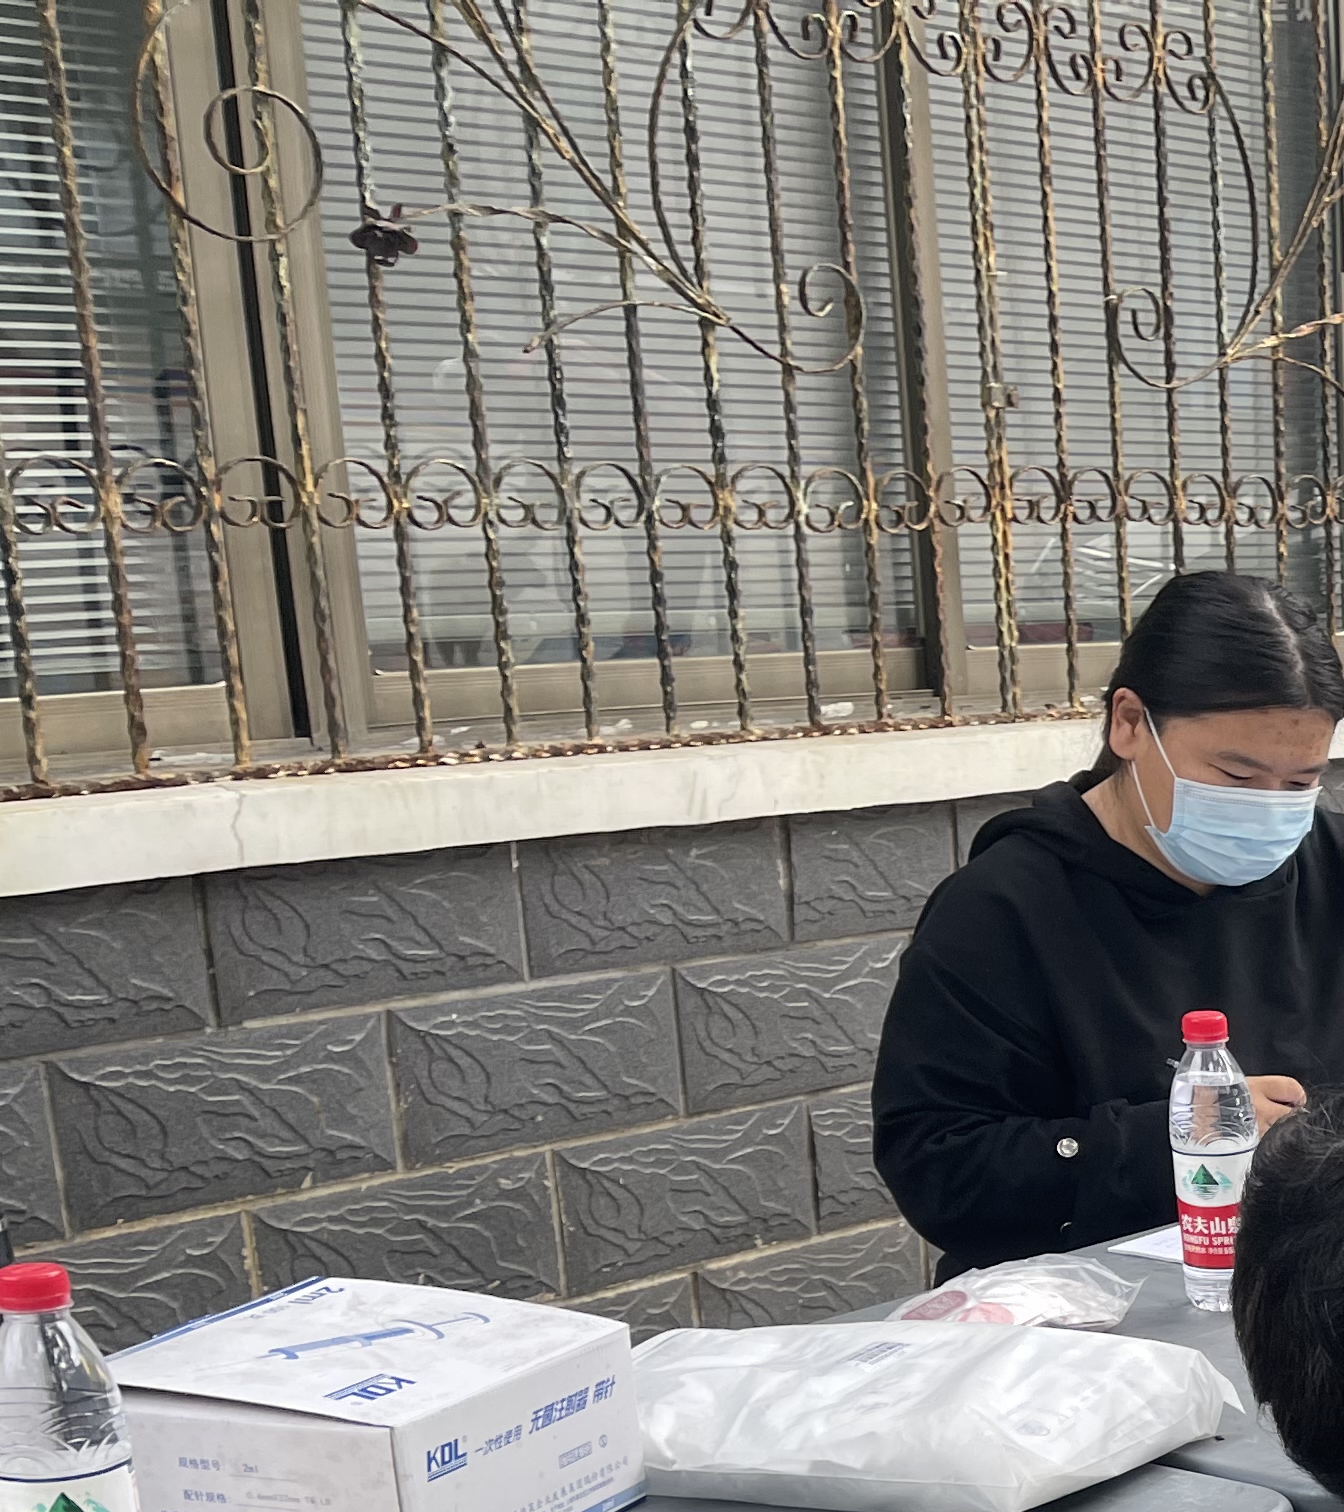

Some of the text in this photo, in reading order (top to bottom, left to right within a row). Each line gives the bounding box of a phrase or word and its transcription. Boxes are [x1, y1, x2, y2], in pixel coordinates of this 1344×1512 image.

[1211, 1235, 1235, 1246] SPRI
[335, 1376, 417, 1401] KDL
[427, 1438, 468, 1472] KDL
